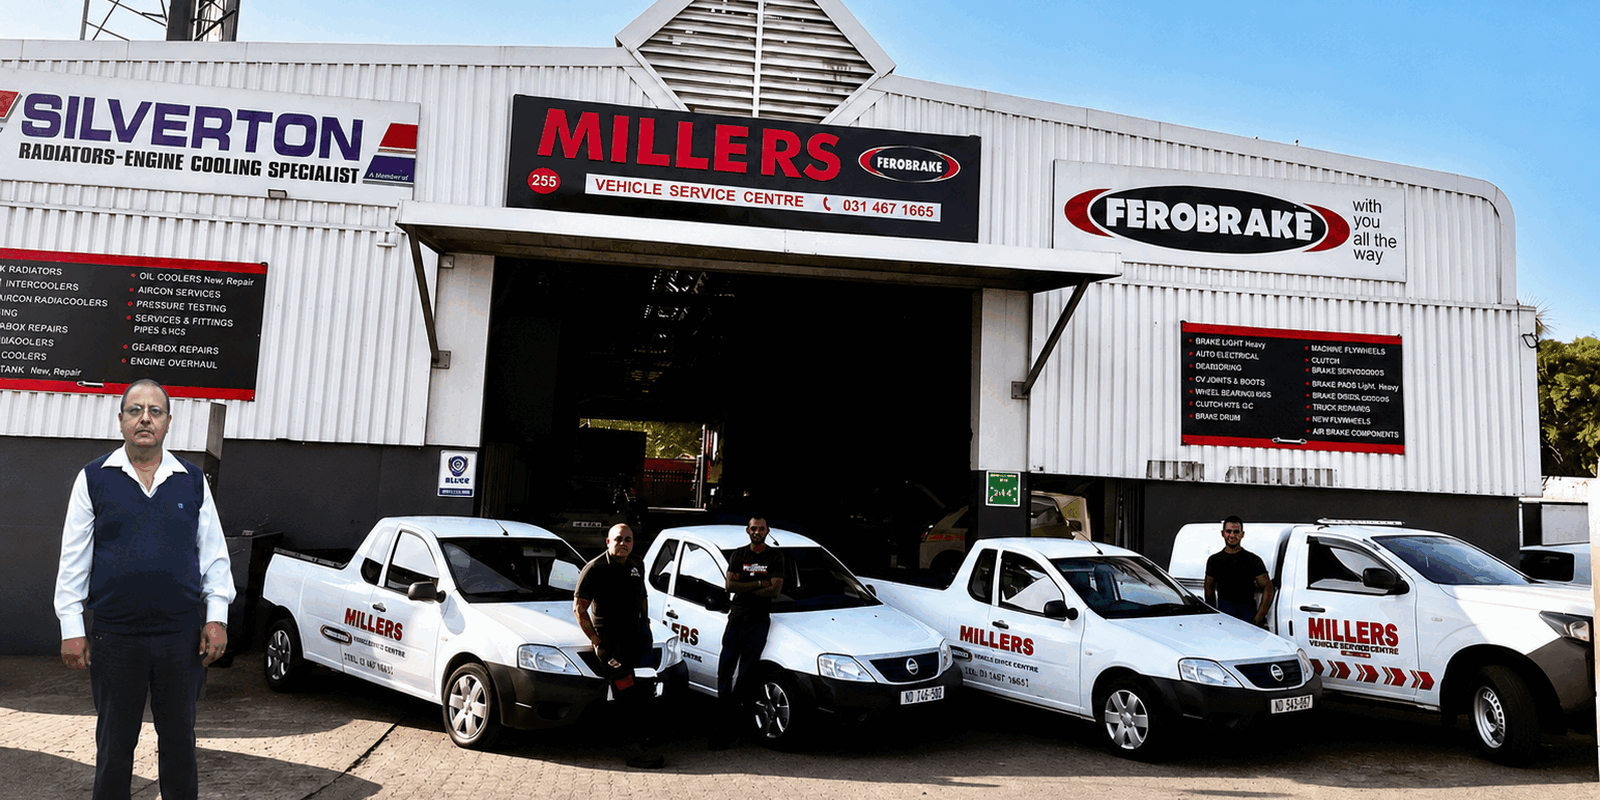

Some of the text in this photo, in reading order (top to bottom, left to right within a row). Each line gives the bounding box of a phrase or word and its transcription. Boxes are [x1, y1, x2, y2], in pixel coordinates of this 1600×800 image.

[21, 93, 364, 162] SILVERTON
[537, 108, 841, 181] MILLERS
[19, 142, 360, 184] RADIATORS-ENGINE COOLING SPECIALIST
[876, 156, 943, 173] FEROBRAKE
[532, 174, 557, 188] 255
[595, 178, 934, 218] VEHICLE SERVICE CENTRE 031 467 1665
[1352, 198, 1382, 214] with
[1106, 197, 1313, 241] FEROBRAKE
[1353, 214, 1380, 230] you
[1353, 233, 1397, 248] all the
[1353, 249, 1384, 266] way
[9, 266, 62, 276] RADIATORS
[6, 280, 80, 292] INTERCOOLERS
[140, 272, 154, 280] OIL
[157, 273, 202, 284] COOLERS
[226, 277, 254, 287] Repair
[138, 286, 221, 298] AIRCON SERVICES
[34, 296, 108, 307] RADIACOOLERS
[136, 300, 226, 313] PRESSURE TESTING
[135, 314, 180, 324] SERVICES
[192, 318, 234, 328] FITTINGS
[28, 324, 68, 334] REPAIRS
[134, 326, 160, 334] PIPES
[2, 351, 47, 361] COOLERS
[132, 343, 220, 355] GEARBOX REPAIRS
[1216, 352, 1260, 360] ELECTRICAL
[130, 357, 218, 369] ENGINE OVERHAUL
[0, 365, 24, 374] TANK
[54, 368, 82, 378] Repair
[1240, 378, 1266, 386] BOOTS
[344, 607, 403, 642] MILLERS
[1308, 617, 1399, 647] MILLERS
[960, 624, 1034, 656] MILLERS
